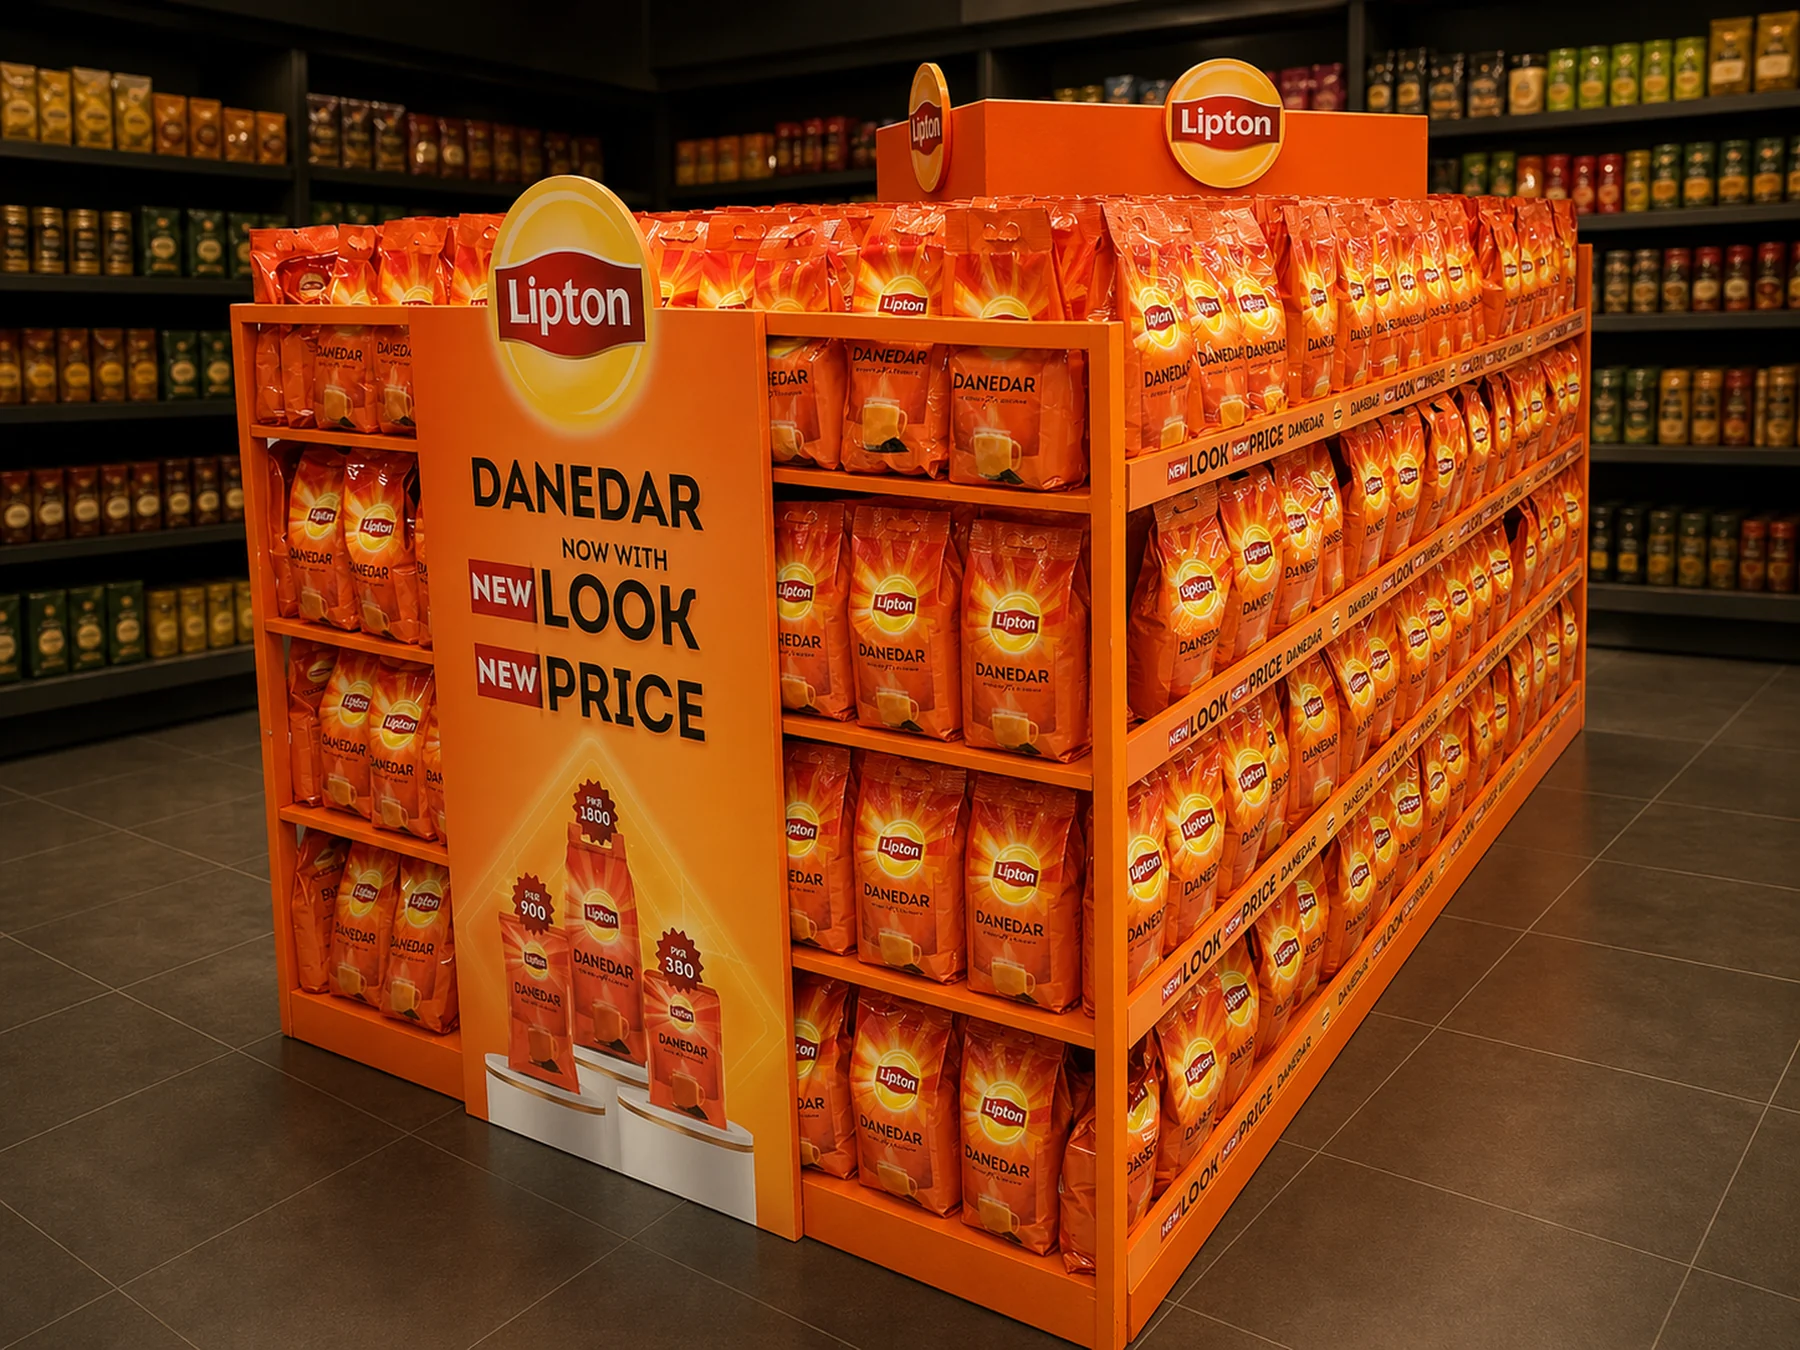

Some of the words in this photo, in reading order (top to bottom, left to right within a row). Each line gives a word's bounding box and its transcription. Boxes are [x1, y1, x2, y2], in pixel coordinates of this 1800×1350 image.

[912, 116, 940, 147] Lipton
[1181, 107, 1271, 141] Lipton
[508, 276, 631, 336] Lipton
[883, 296, 924, 312] Lipton
[852, 347, 927, 365] DANEDAR
[953, 373, 1035, 393] DANEDAR
[1168, 461, 1188, 481] NEW
[1188, 442, 1229, 478] LOOK
[1249, 424, 1284, 456] PRICE
[471, 456, 704, 531] DANEDAR
[562, 537, 609, 563] NOW
[614, 543, 668, 571] WITH
[777, 584, 811, 600] Lipton
[877, 595, 913, 613] Lipton
[472, 572, 533, 608] NEW
[541, 568, 700, 651] LOOK
[996, 613, 1035, 632] Lipton
[859, 643, 925, 663] DANEDAR
[976, 662, 1049, 684] DANEDAR
[478, 656, 537, 693] NEW
[546, 655, 706, 742] PRICE
[1169, 727, 1189, 747] NEW
[1189, 696, 1228, 738] LOOK
[1249, 655, 1283, 694] PRICE
[1286, 628, 1323, 663] DANEDAR
[580, 806, 610, 827] 1800
[882, 839, 919, 857] Lipton
[998, 864, 1034, 883] Lipton
[864, 882, 930, 908] DANEDAR
[520, 901, 546, 921] 900
[586, 907, 616, 926] Lipton
[1182, 928, 1223, 983] LOOK
[1241, 873, 1276, 926] PRICE
[1281, 835, 1317, 882] DANEDAR
[976, 910, 1043, 937] DANEDAR
[574, 949, 634, 981] DANEDAR
[665, 957, 694, 978] 380
[514, 981, 561, 1008] DANEDAR
[658, 1032, 708, 1059] DANEDAR
[880, 1068, 915, 1091] Lipton
[985, 1100, 1023, 1124] Lipton
[860, 1114, 922, 1146] DANEDAR
[965, 1144, 1029, 1179] DANEDAR
[1181, 1151, 1219, 1217] LOOK
[1238, 1084, 1273, 1138] PRICE
